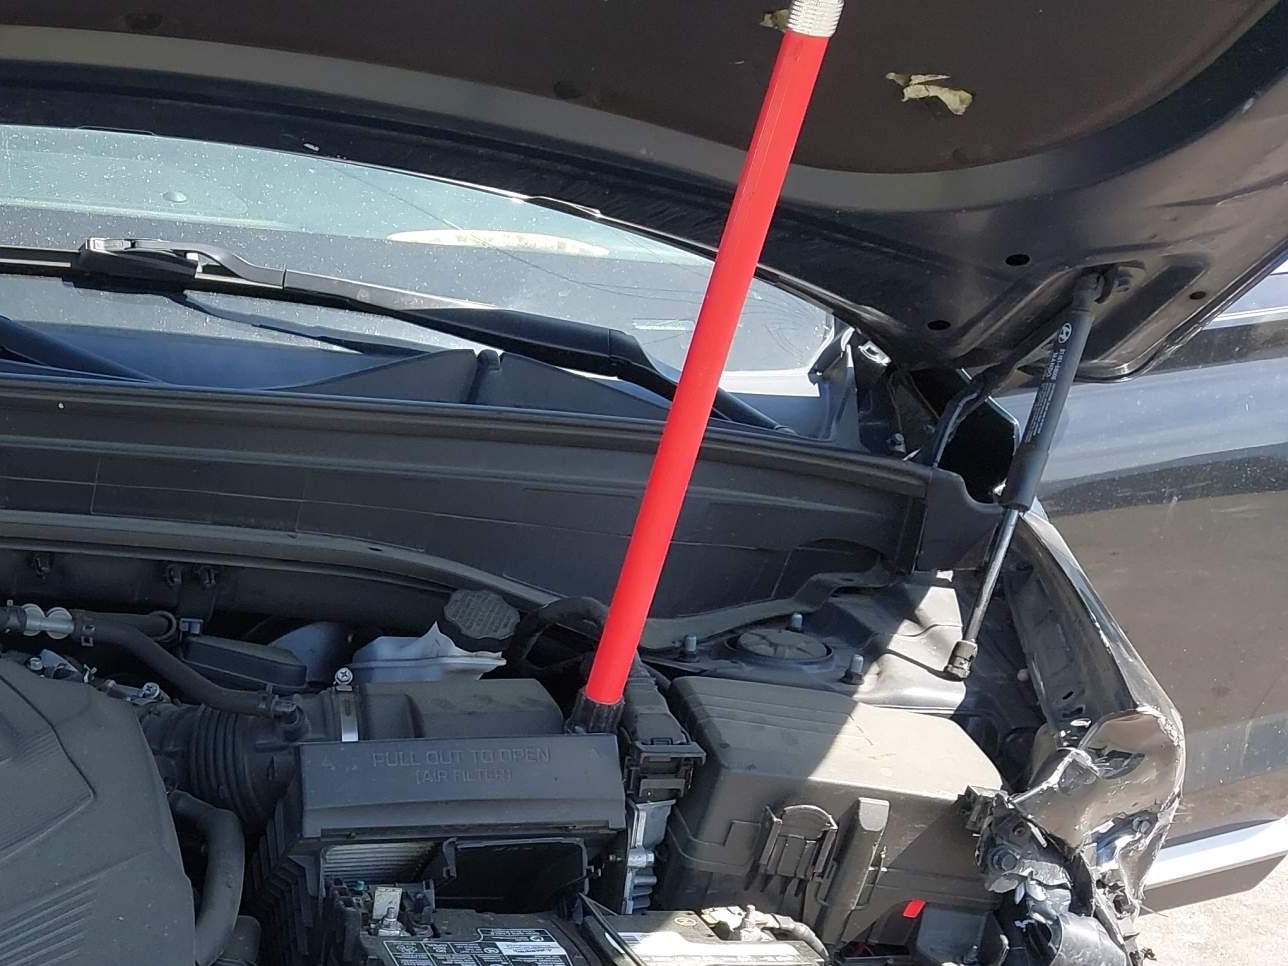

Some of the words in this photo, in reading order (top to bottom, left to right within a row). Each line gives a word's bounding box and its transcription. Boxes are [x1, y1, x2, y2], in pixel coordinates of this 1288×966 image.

[425, 750, 462, 765] OUT
[472, 750, 496, 764] TO
[499, 746, 552, 763] OPEN
